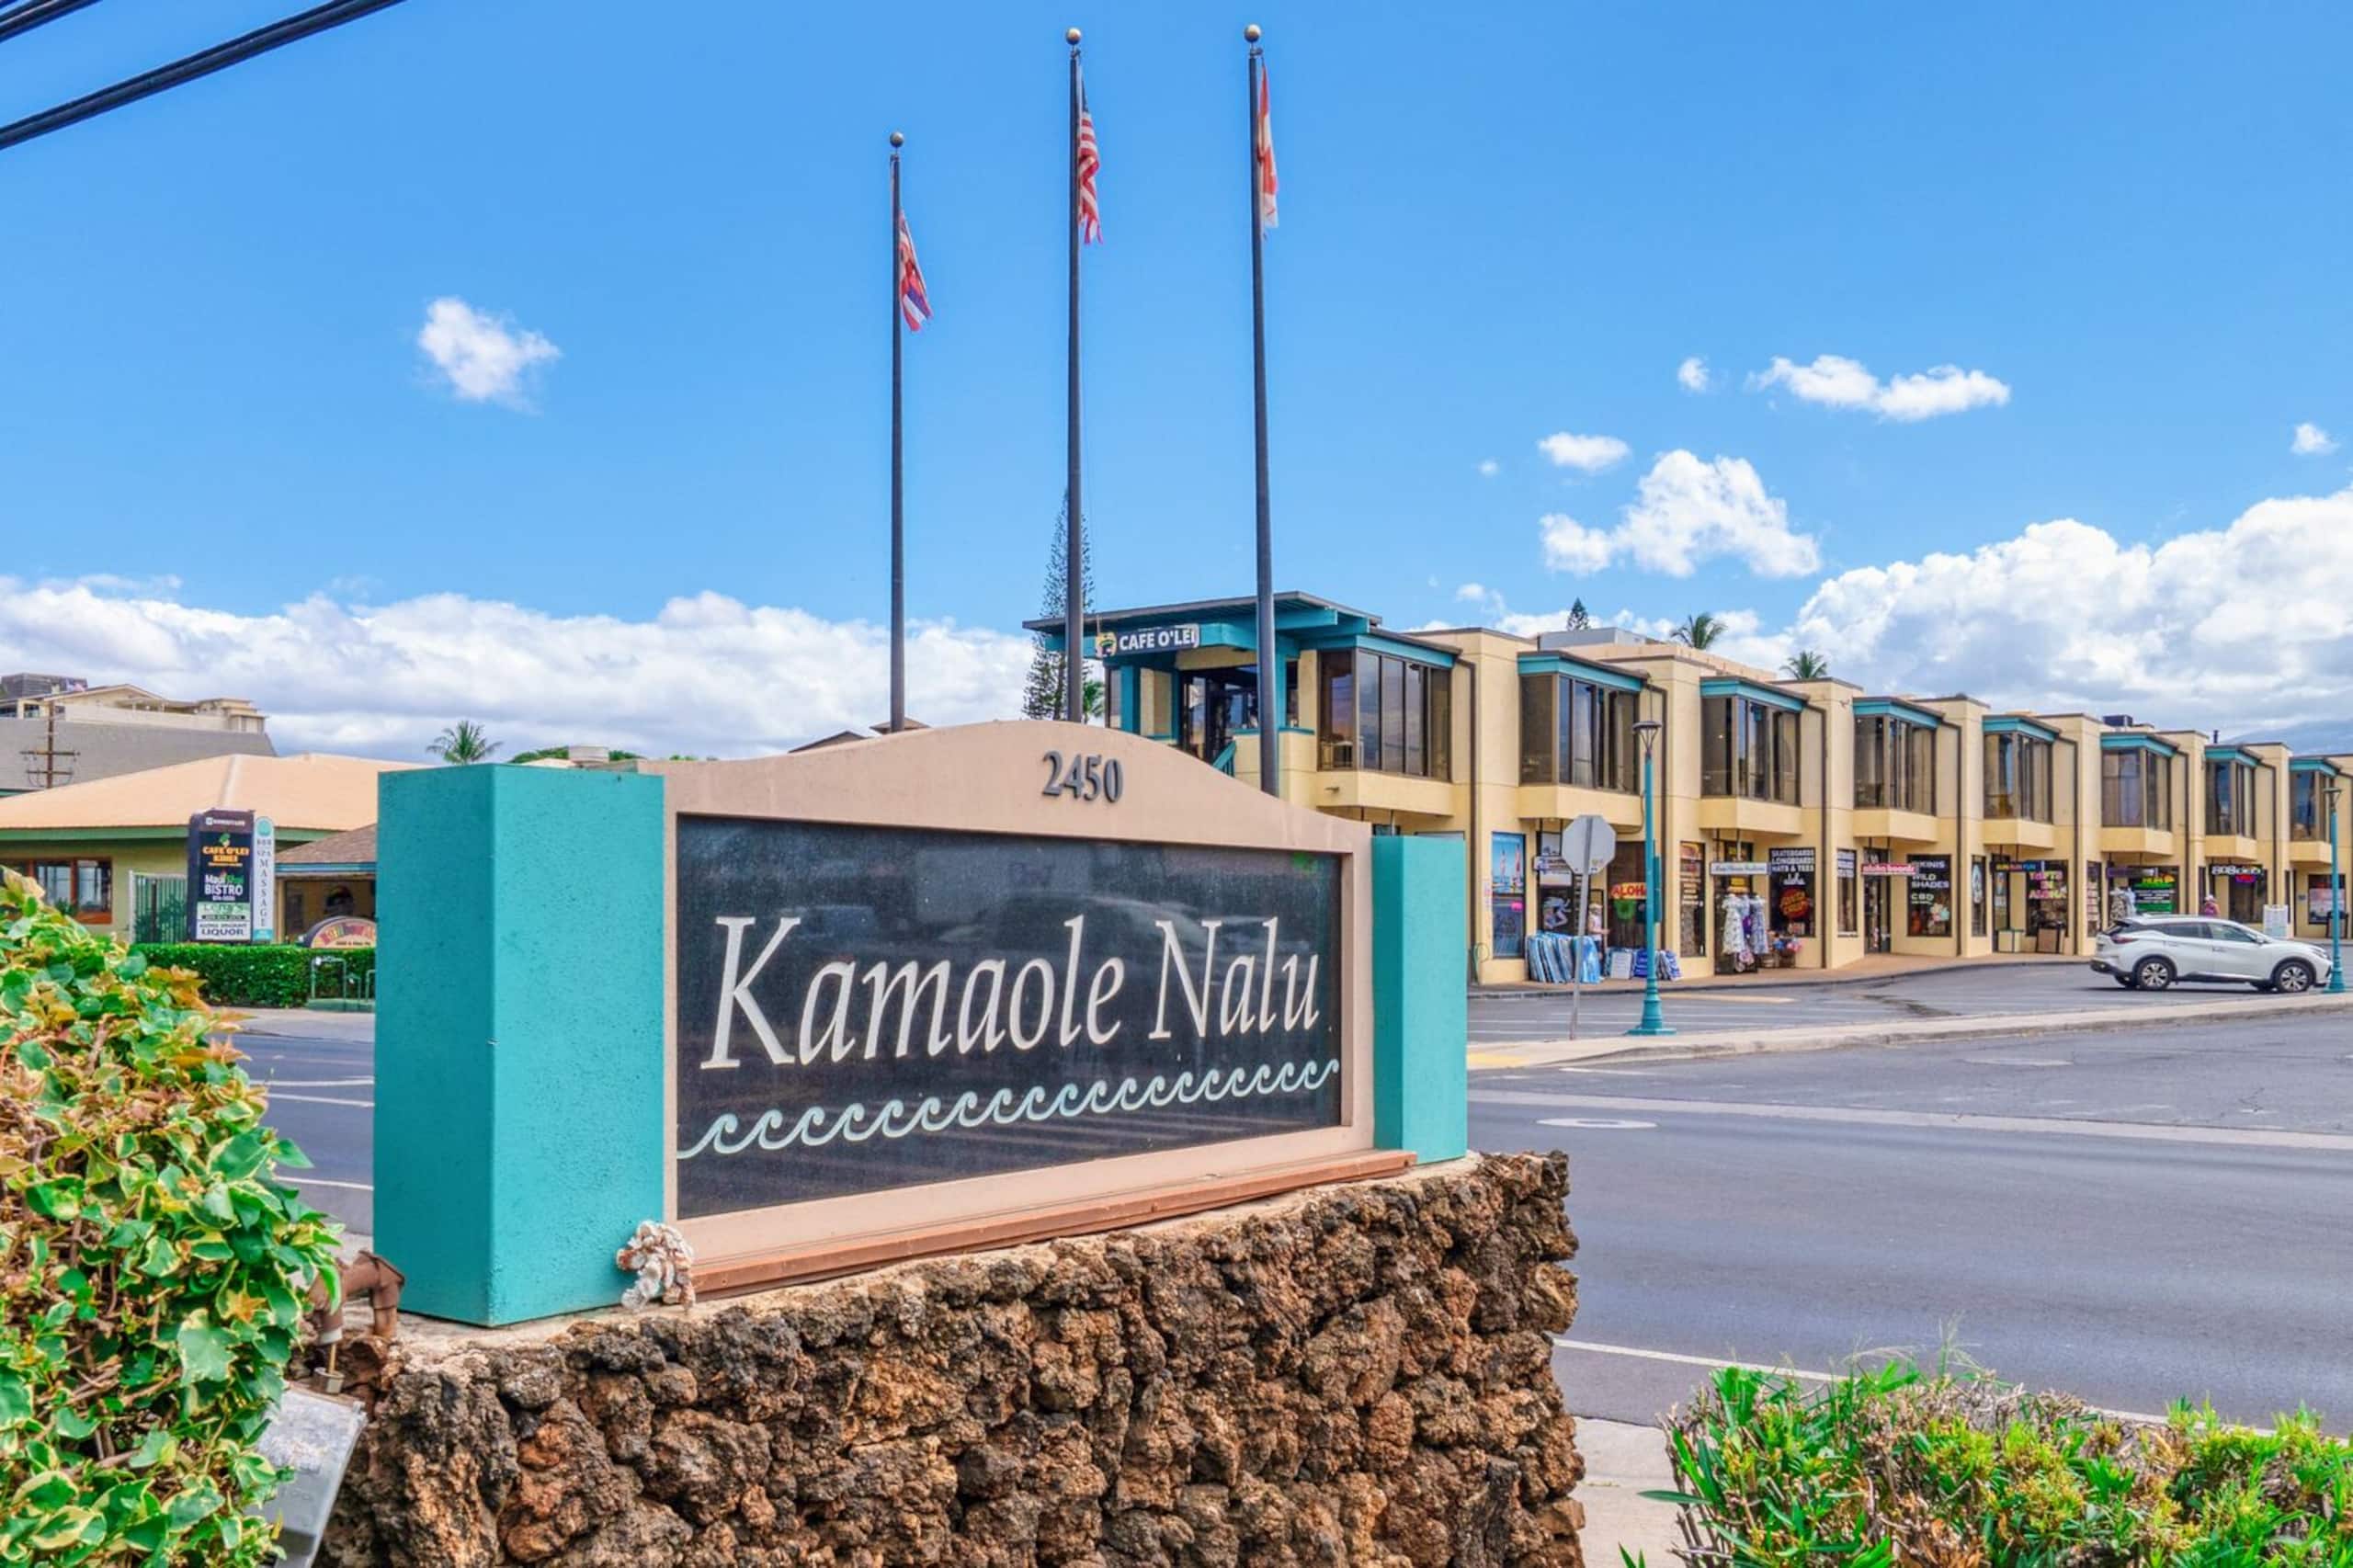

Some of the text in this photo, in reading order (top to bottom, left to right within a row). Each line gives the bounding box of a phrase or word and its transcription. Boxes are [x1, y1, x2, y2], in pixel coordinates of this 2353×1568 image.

[1120, 629, 1196, 651] CAFE O'LEI
[1041, 750, 1123, 803] 2450
[205, 884, 244, 896] BISTRO
[260, 858, 268, 927] MASSAGE
[699, 915, 1320, 1071] Kamaole Nalu
